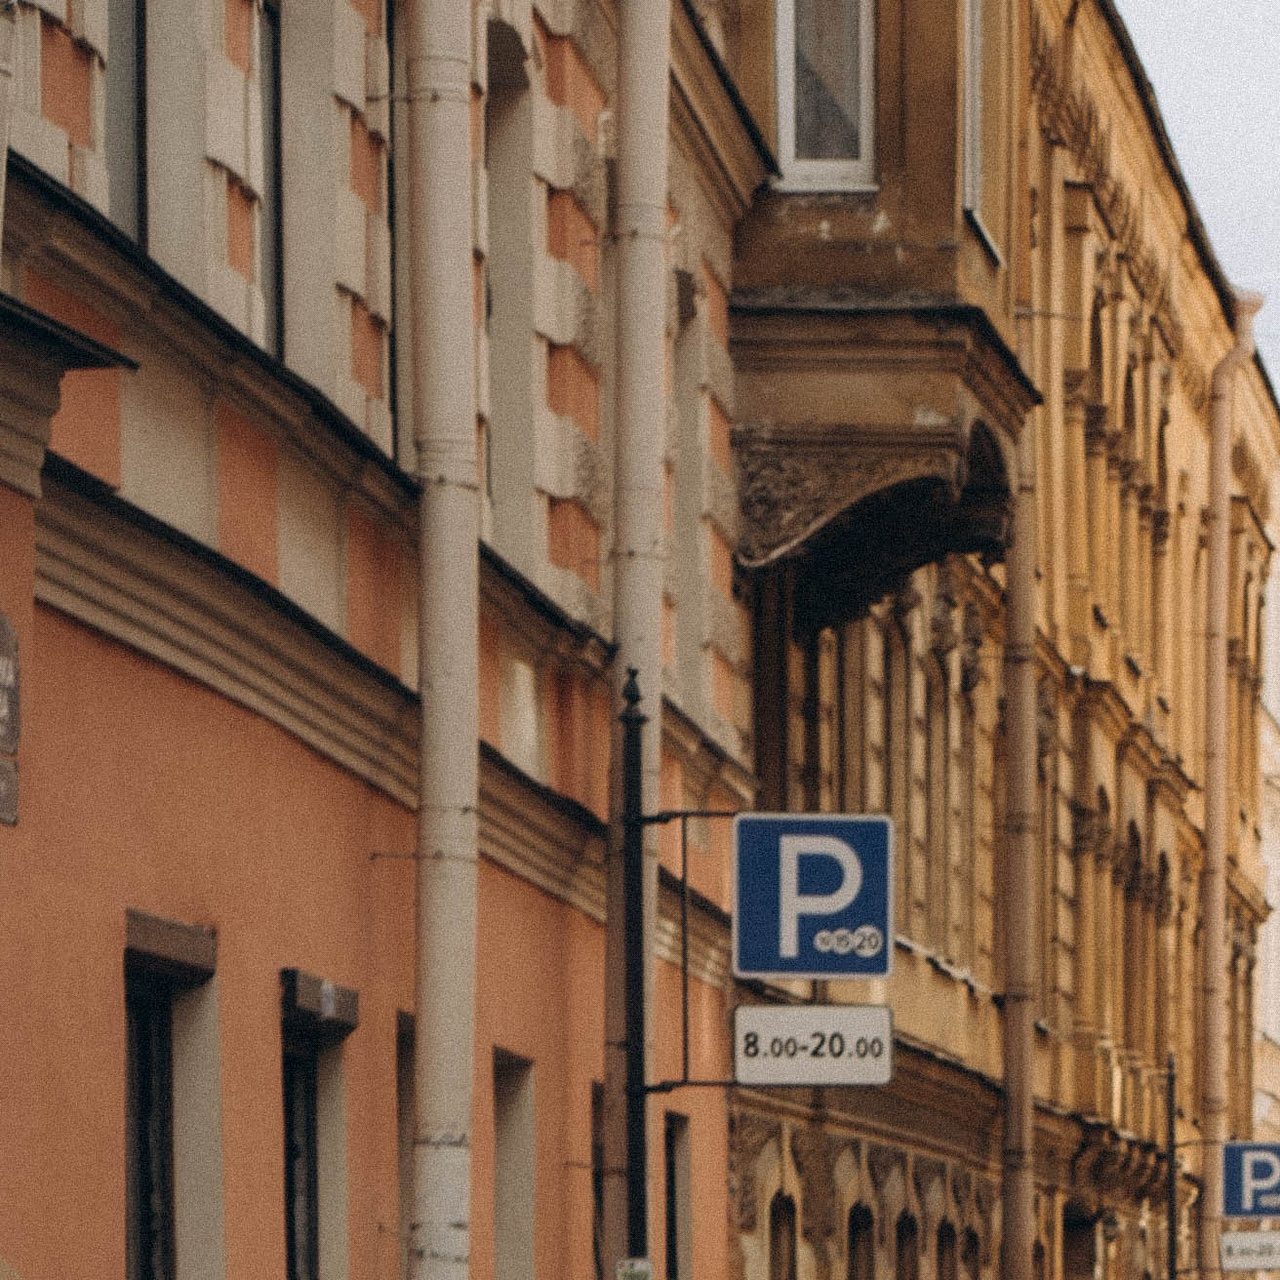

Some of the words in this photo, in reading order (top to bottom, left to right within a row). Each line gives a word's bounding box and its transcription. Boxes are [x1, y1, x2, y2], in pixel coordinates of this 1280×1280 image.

[778, 833, 864, 959] P
[857, 932, 880, 950] 20
[743, 1030, 884, 1058] 8.00-20.00
